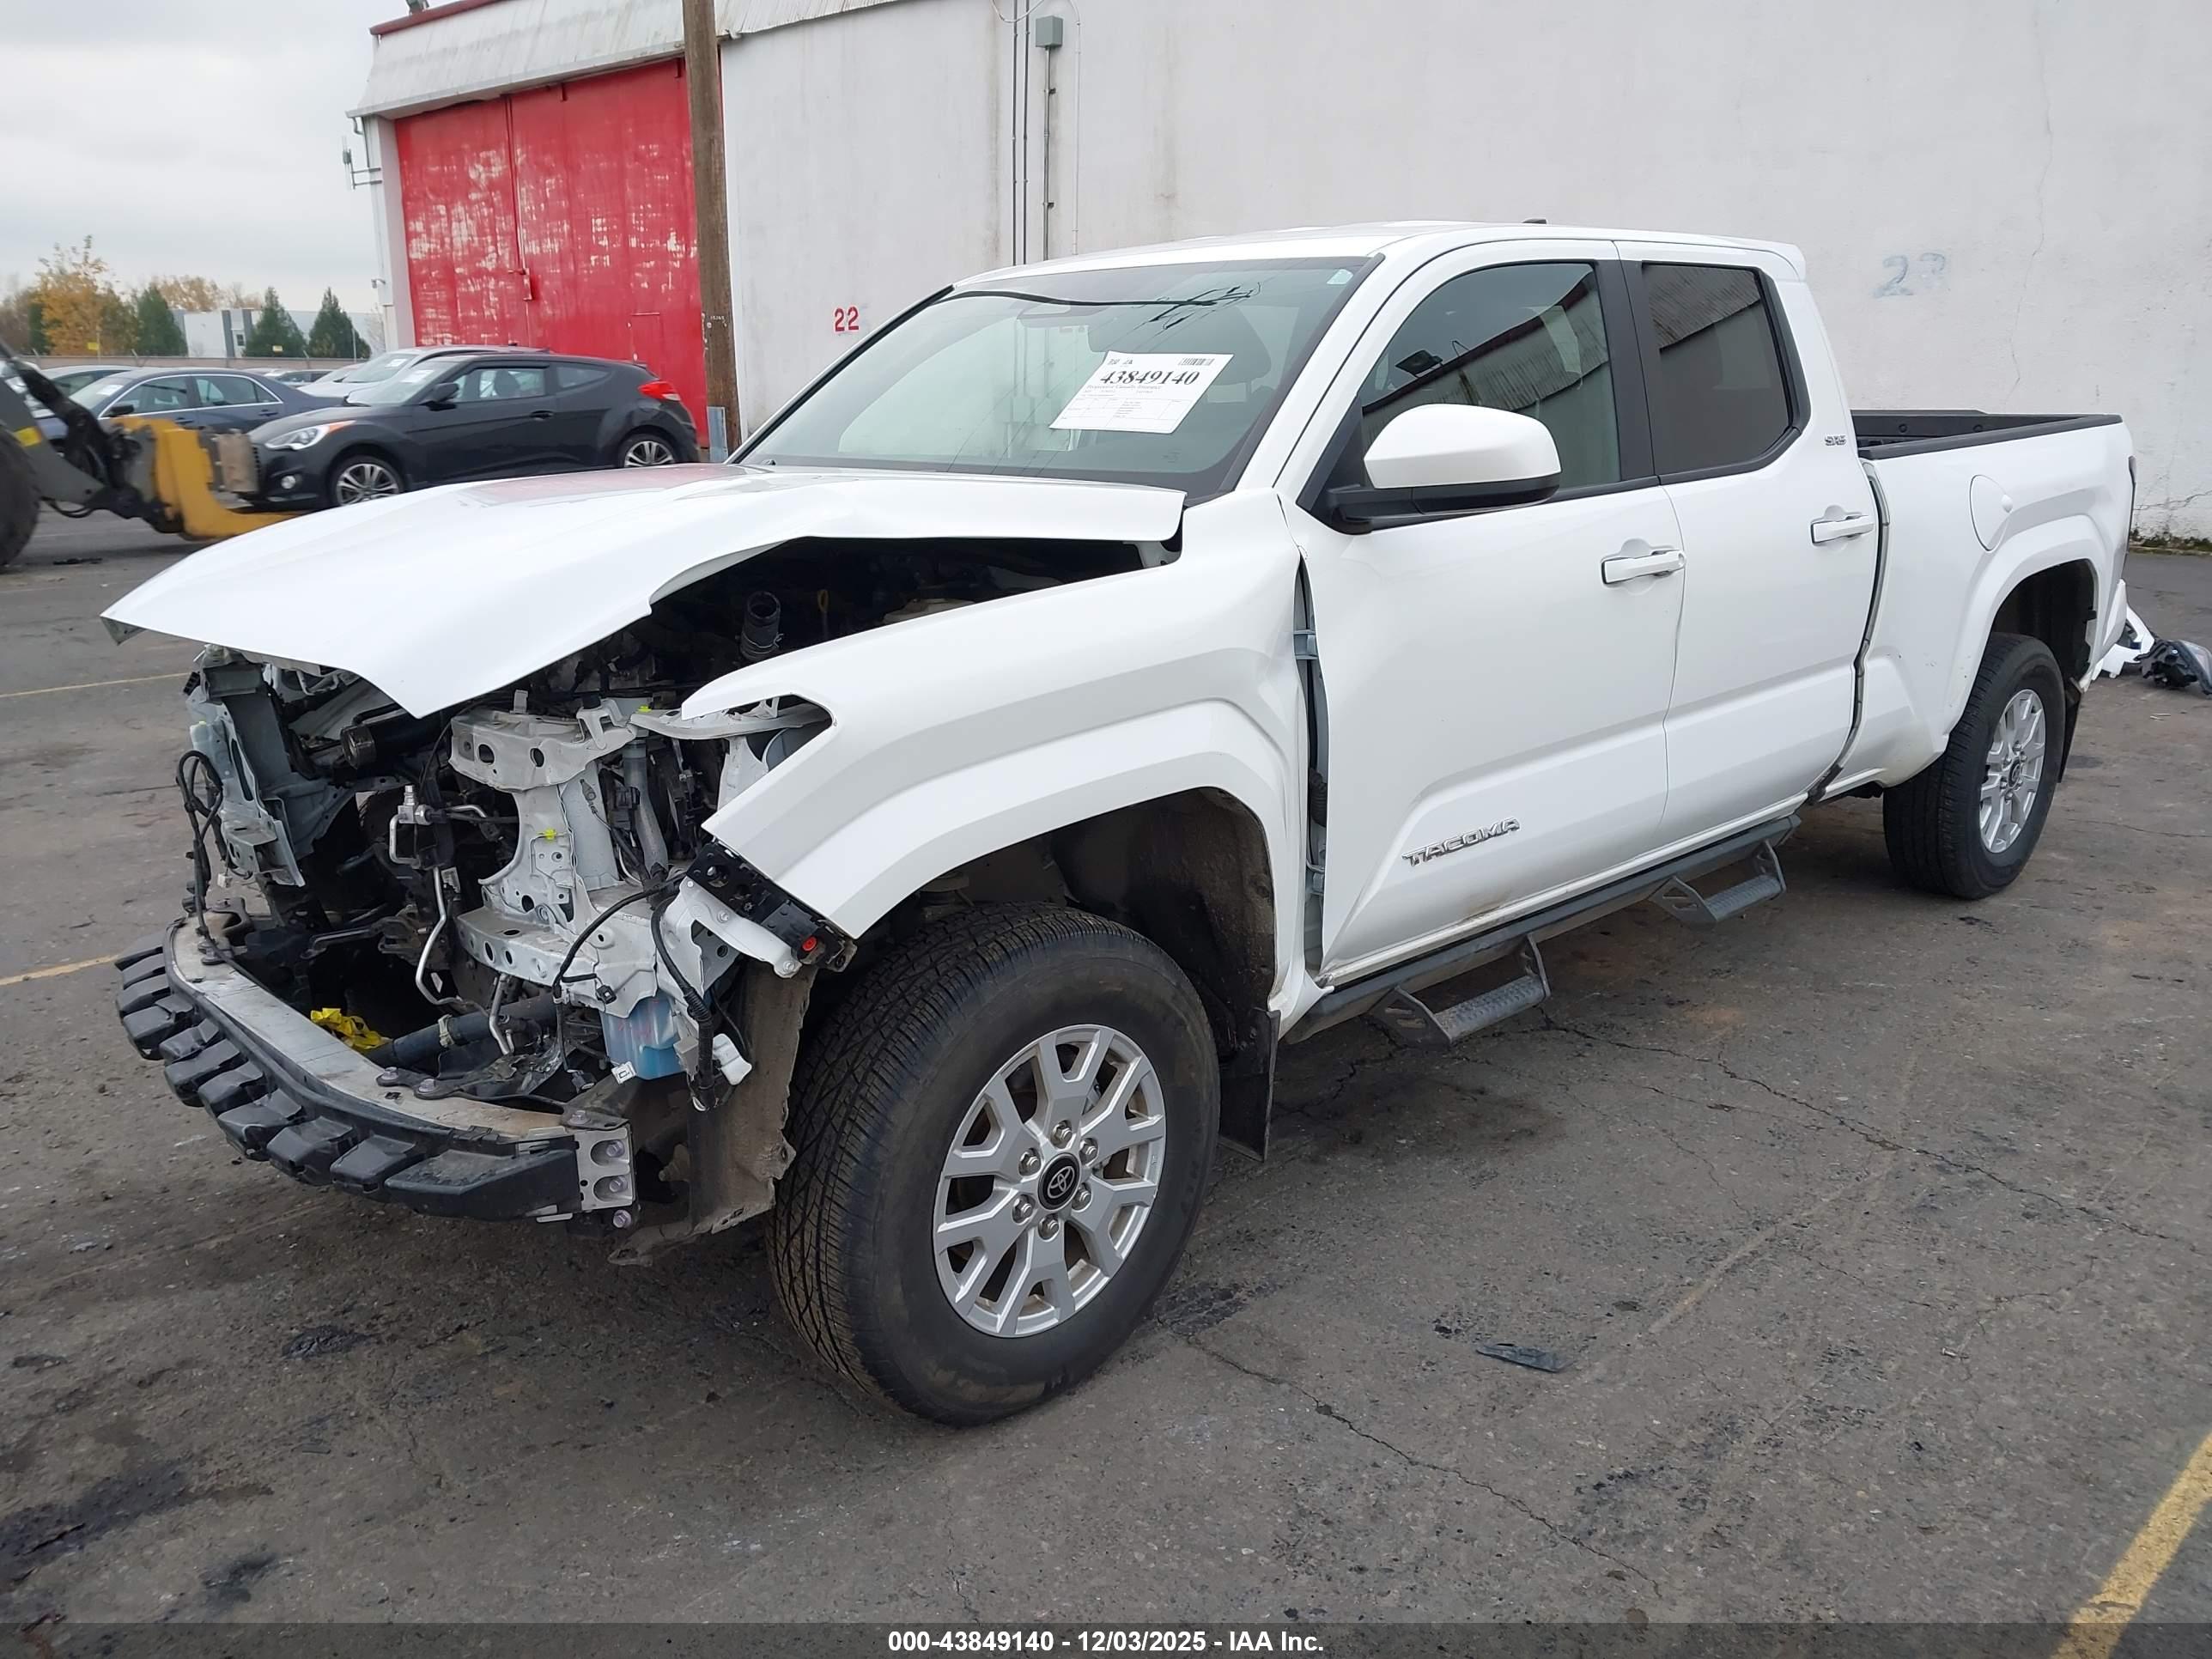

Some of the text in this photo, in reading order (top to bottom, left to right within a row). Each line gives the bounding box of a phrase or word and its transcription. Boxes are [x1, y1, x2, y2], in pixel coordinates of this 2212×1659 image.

[834, 306, 860, 332] 22
[1100, 370, 1200, 386] 43849140
[1401, 817, 1521, 866] TACOMA
